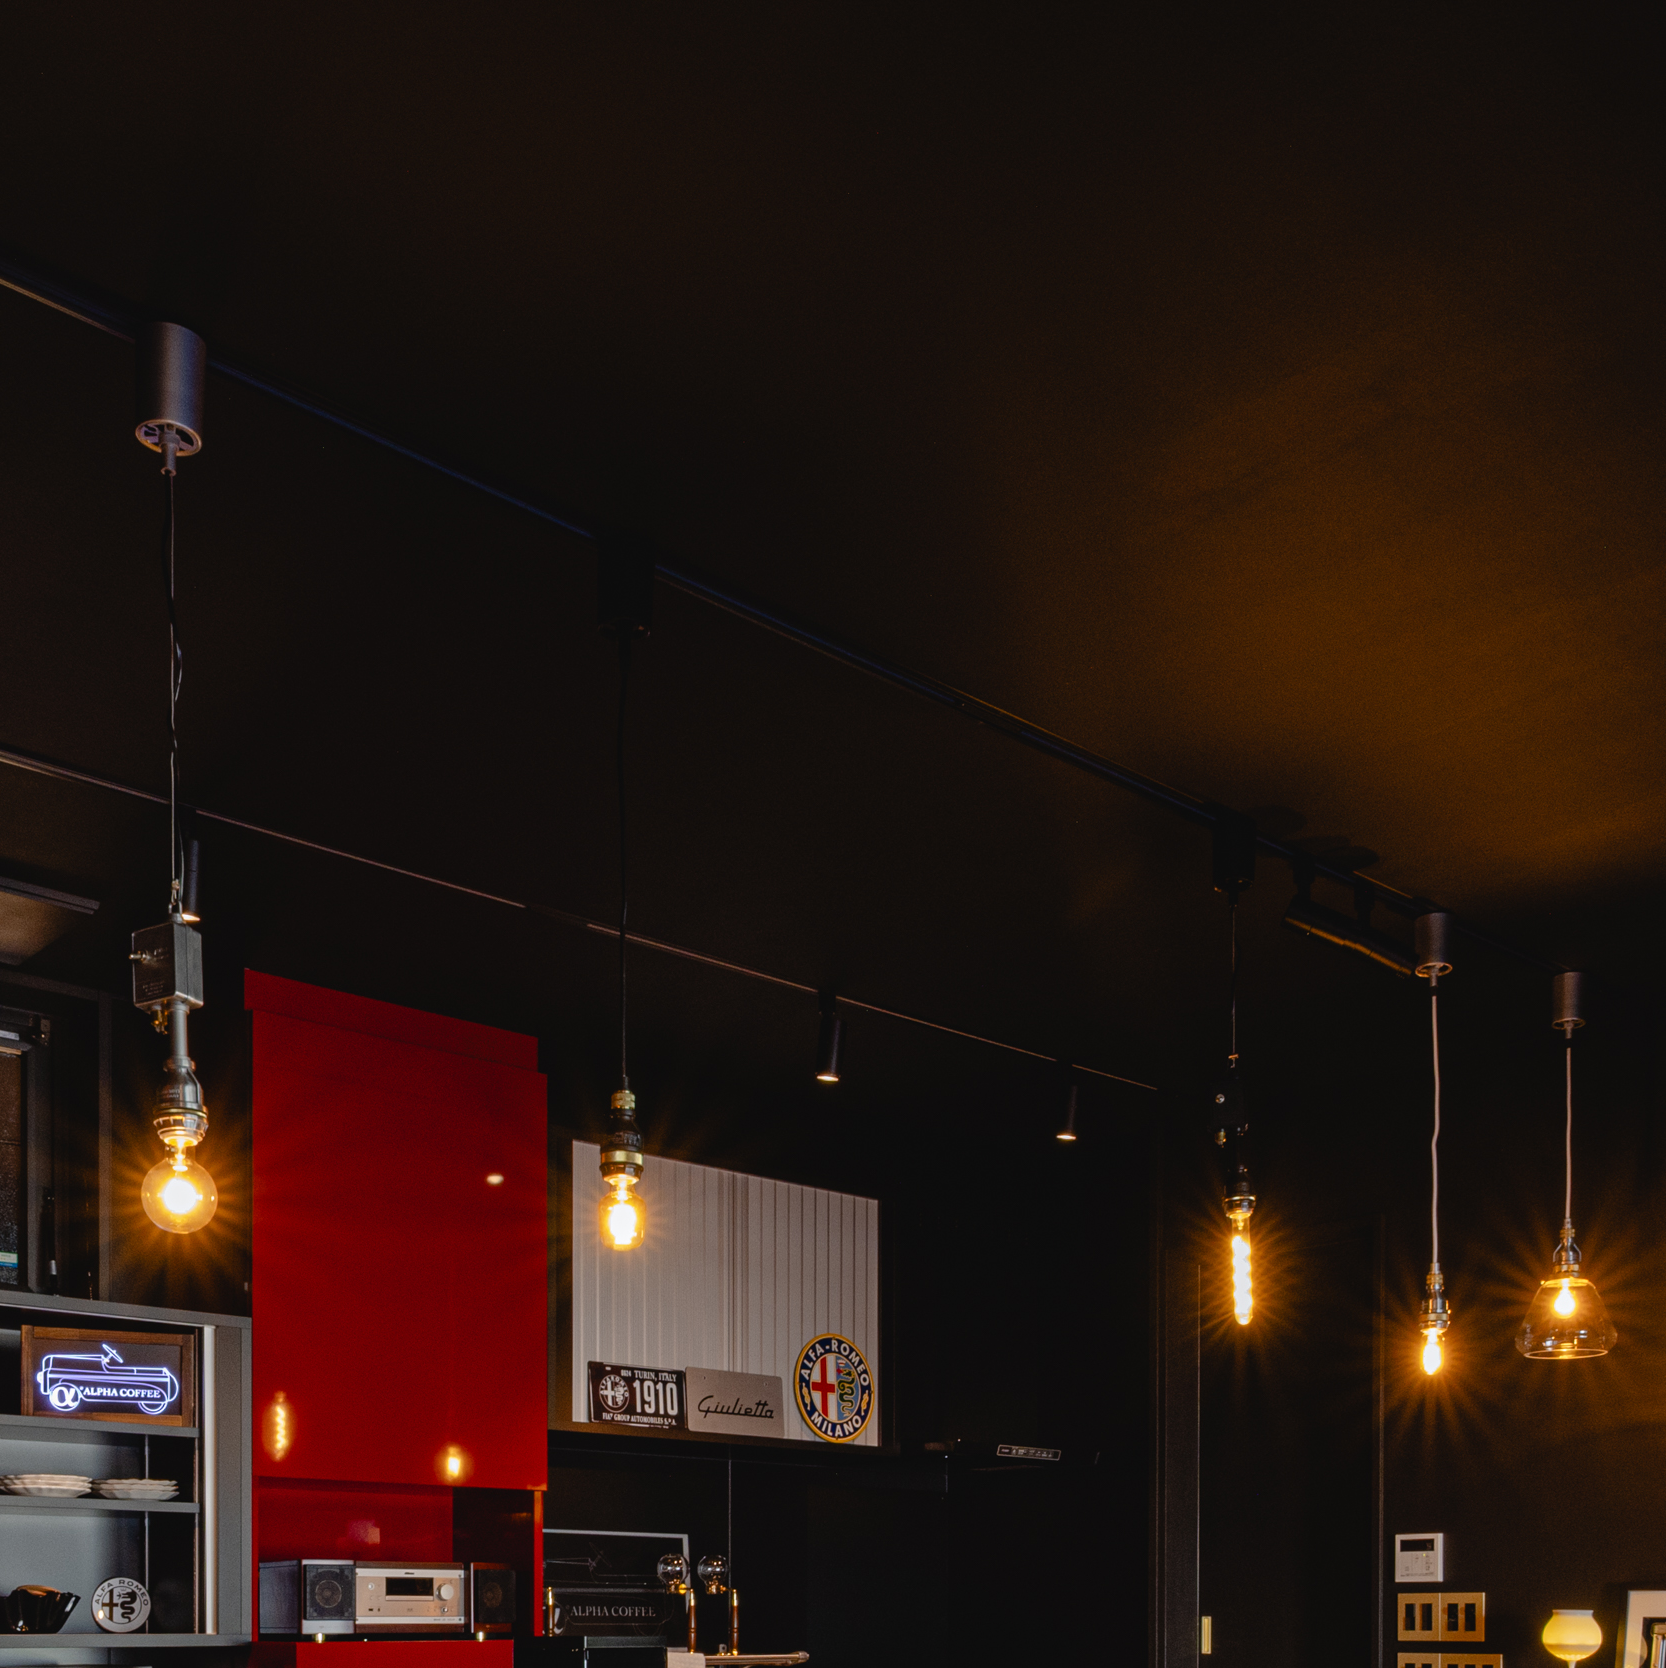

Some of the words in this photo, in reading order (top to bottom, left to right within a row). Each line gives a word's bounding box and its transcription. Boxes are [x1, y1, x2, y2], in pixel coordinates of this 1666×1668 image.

[658, 1372, 677, 1382] ITALY
[83, 1387, 118, 1397] ALPHA
[119, 1388, 161, 1398] COFFEE
[633, 1379, 678, 1415] 1910
[698, 1395, 774, 1419] Giulietta
[614, 1413, 630, 1422] GROUP
[811, 1412, 862, 1437] MILANO
[95, 1582, 113, 1605] ALFA
[118, 1579, 149, 1606] ROMEO
[571, 1606, 609, 1616] ALPHA
[611, 1606, 656, 1617] COFFEE
